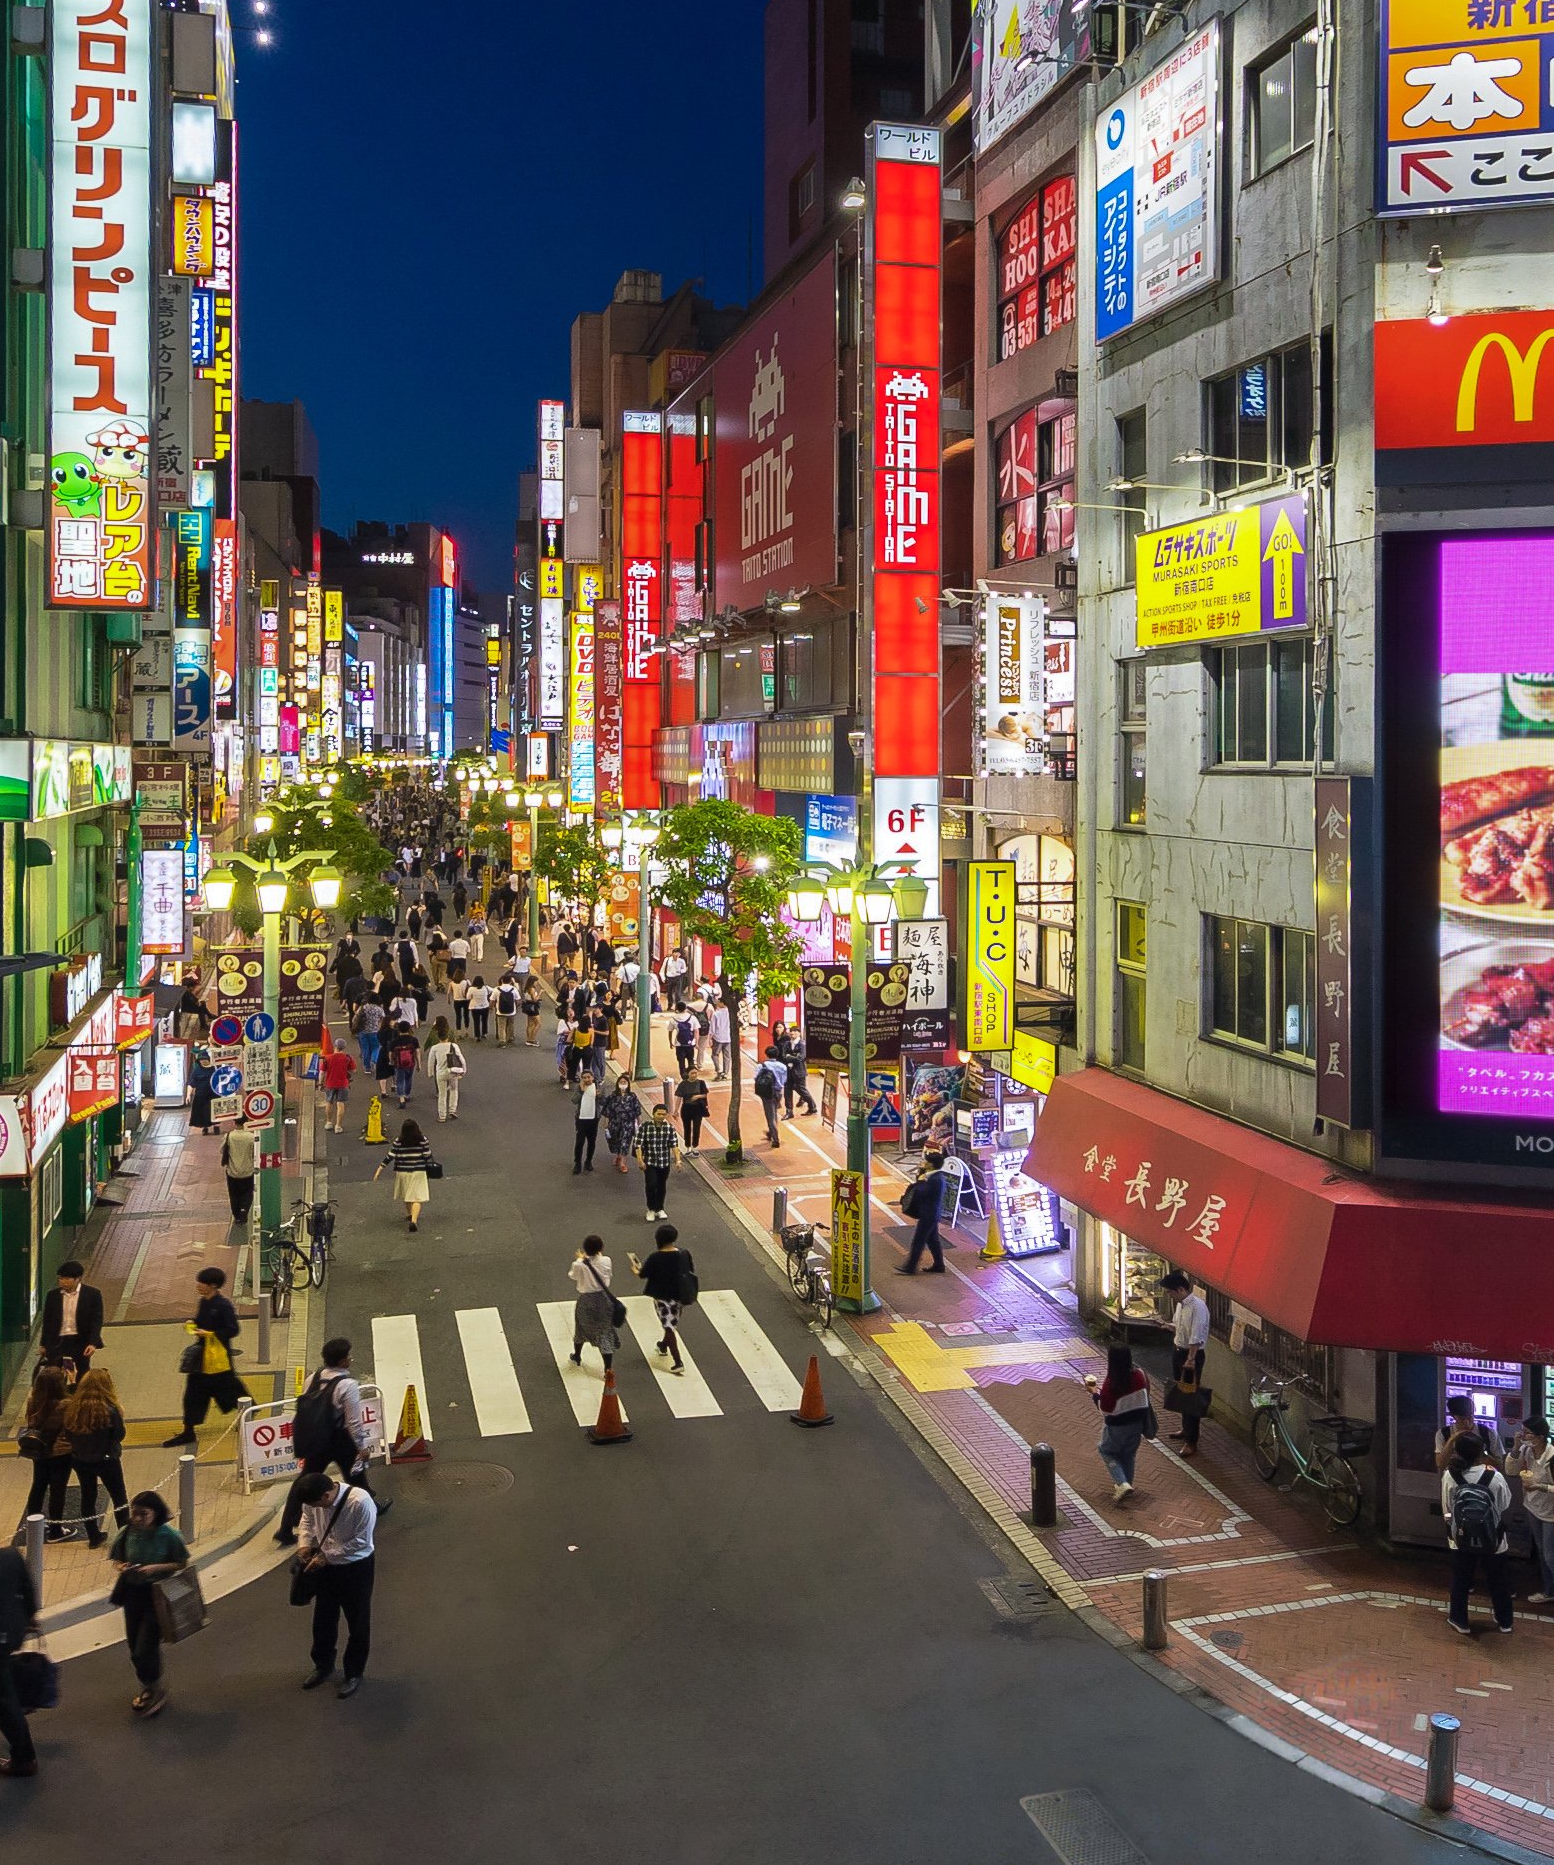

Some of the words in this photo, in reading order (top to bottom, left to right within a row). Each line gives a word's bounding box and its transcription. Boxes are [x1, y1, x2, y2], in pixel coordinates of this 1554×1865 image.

[1402, 51, 1524, 131] 本
[877, 128, 931, 145] ワールド
[908, 147, 937, 163] ビル
[1103, 200, 1117, 316] アイシティ
[1117, 189, 1128, 311] コンタクトの
[624, 413, 657, 423] ワールド
[884, 402, 895, 468] TAITO
[741, 433, 794, 551] GAME
[895, 403, 930, 565] GAME
[103, 485, 144, 604] レア台の
[883, 473, 895, 564] STATION
[1153, 520, 1239, 568] ムラサキスポーツ
[1273, 531, 1293, 552] GO!
[57, 518, 99, 597] 聖地
[186, 545, 202, 620] RentNavi
[1152, 563, 1199, 583] MURASAKI
[1201, 554, 1239, 574] SPORTS
[1174, 576, 1215, 597] 新宿南口店
[1151, 616, 1203, 638] 甲州街道沿い
[1206, 609, 1241, 631] 徒歩1分
[999, 616, 1016, 698] Princess
[887, 807, 926, 834] 6F
[1320, 802, 1347, 885] 食堂
[902, 925, 943, 948] 麺屋
[901, 1021, 945, 1032] ハイボール
[986, 992, 997, 1034] SHOP
[1320, 913, 1347, 1079] 長野屋
[251, 1097, 269, 1112] 30
[1081, 1144, 1117, 1183] 食堂
[1123, 1161, 1227, 1250] 長野屋
